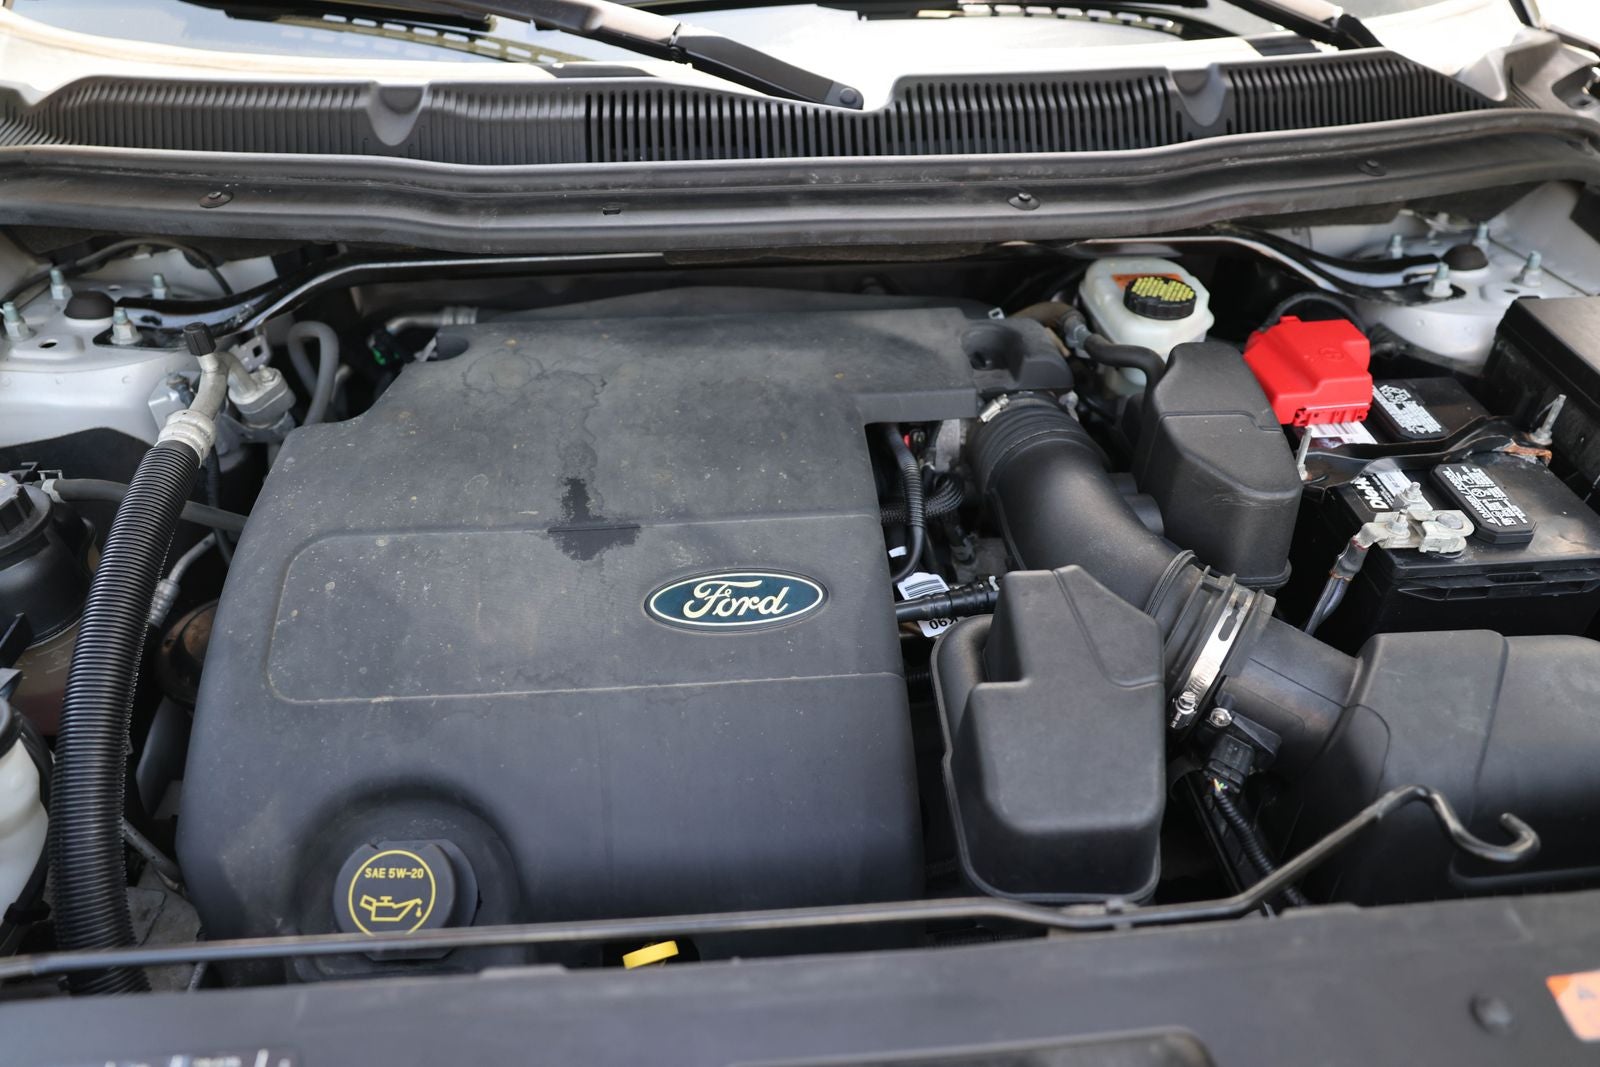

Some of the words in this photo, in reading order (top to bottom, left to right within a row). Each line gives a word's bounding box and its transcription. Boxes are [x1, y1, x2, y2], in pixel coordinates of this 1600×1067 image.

[683, 580, 790, 618] Ford
[364, 867, 386, 878] SAE
[388, 867, 424, 879] 5W-20
